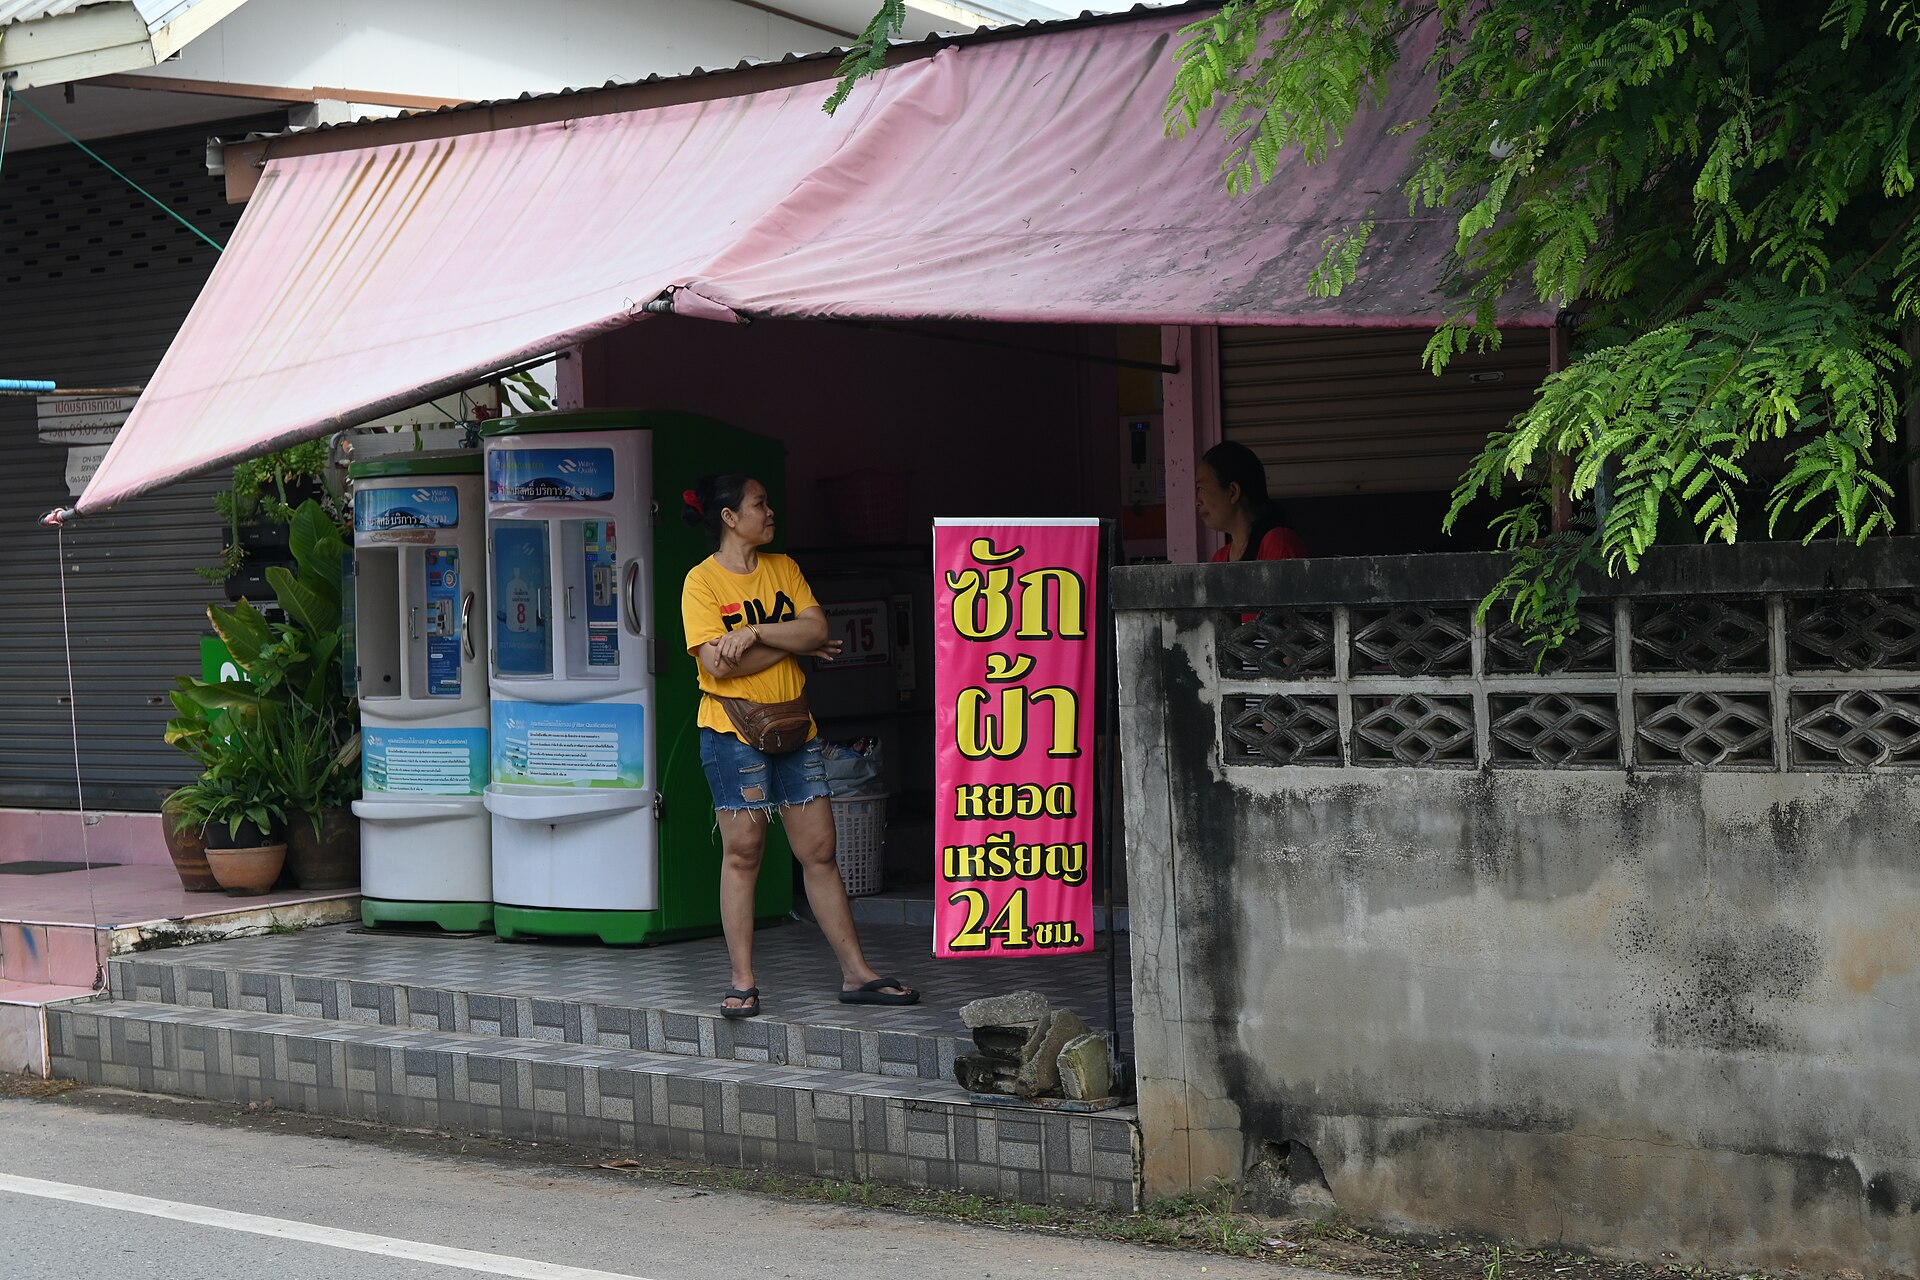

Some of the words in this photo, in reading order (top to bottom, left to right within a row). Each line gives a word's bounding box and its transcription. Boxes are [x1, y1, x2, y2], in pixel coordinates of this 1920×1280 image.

[80, 464, 100, 472] SERVIC
[565, 486, 576, 496] 24
[419, 514, 430, 524] 24
[945, 537, 1087, 642] ซัก
[719, 590, 796, 633] FILA
[846, 617, 875, 654] 15
[955, 652, 1083, 760] ผ้า
[954, 781, 1076, 822] หยอด
[942, 831, 1088, 884] เหรียญ
[948, 887, 1032, 952] 24
[1034, 919, 1084, 948] ชม.
